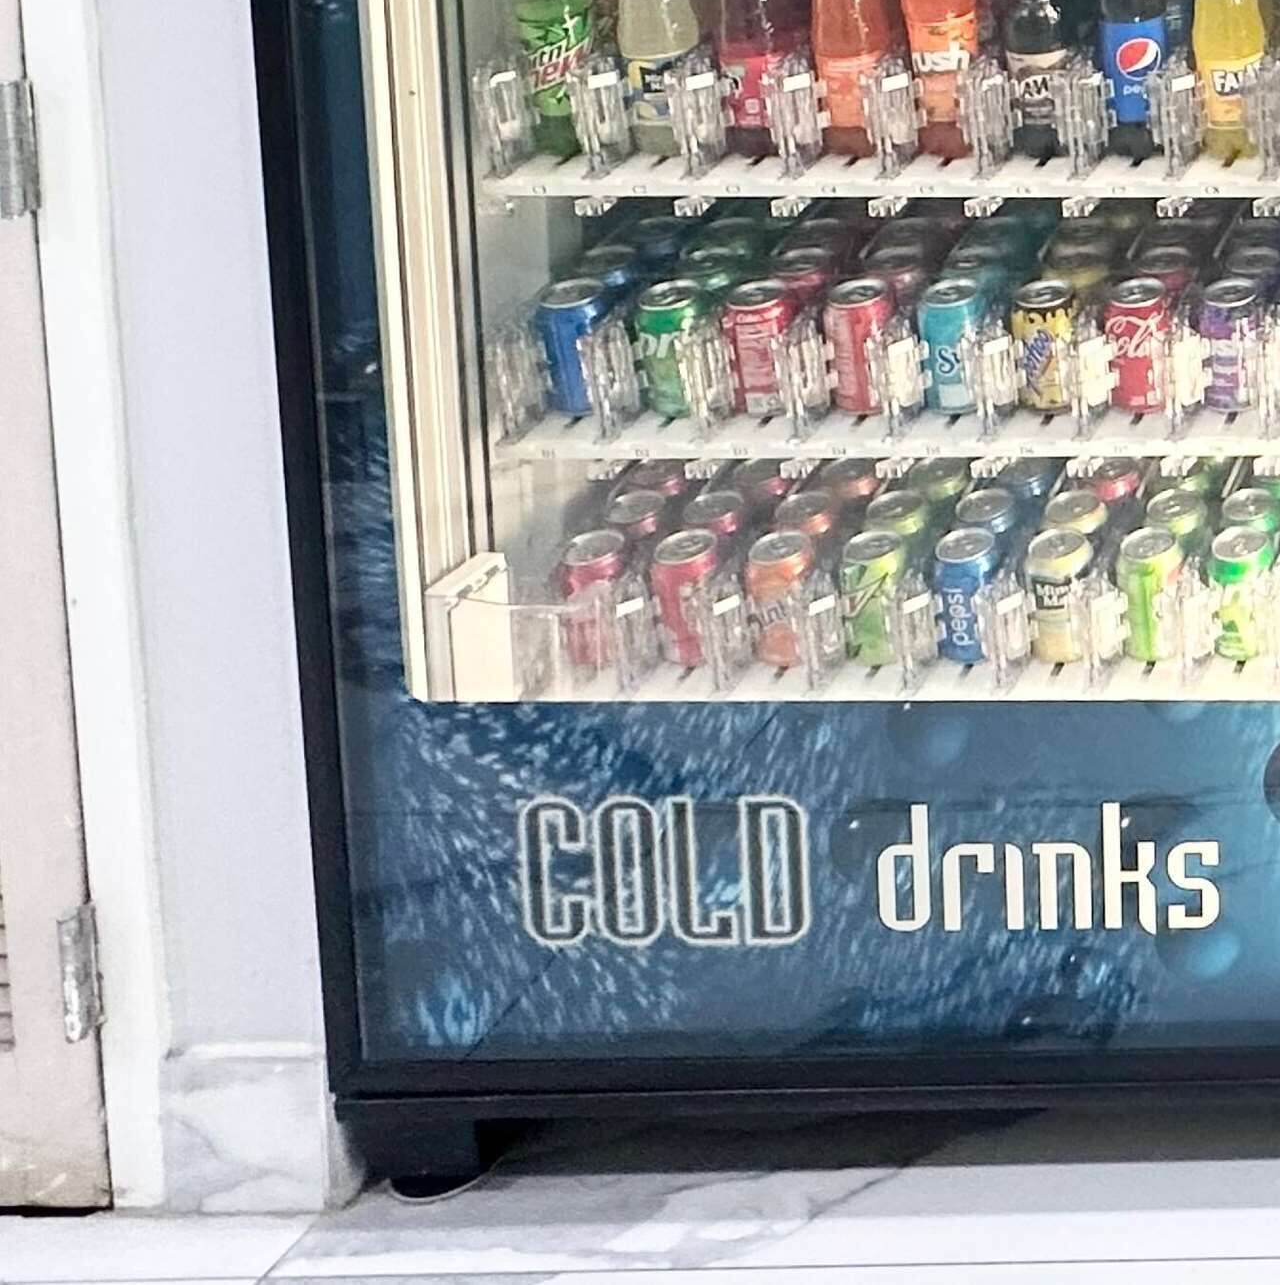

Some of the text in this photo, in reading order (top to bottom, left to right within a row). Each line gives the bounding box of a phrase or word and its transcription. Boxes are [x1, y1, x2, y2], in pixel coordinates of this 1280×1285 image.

[944, 586, 975, 647] pepsi
[518, 794, 1221, 948] COLD drinks
